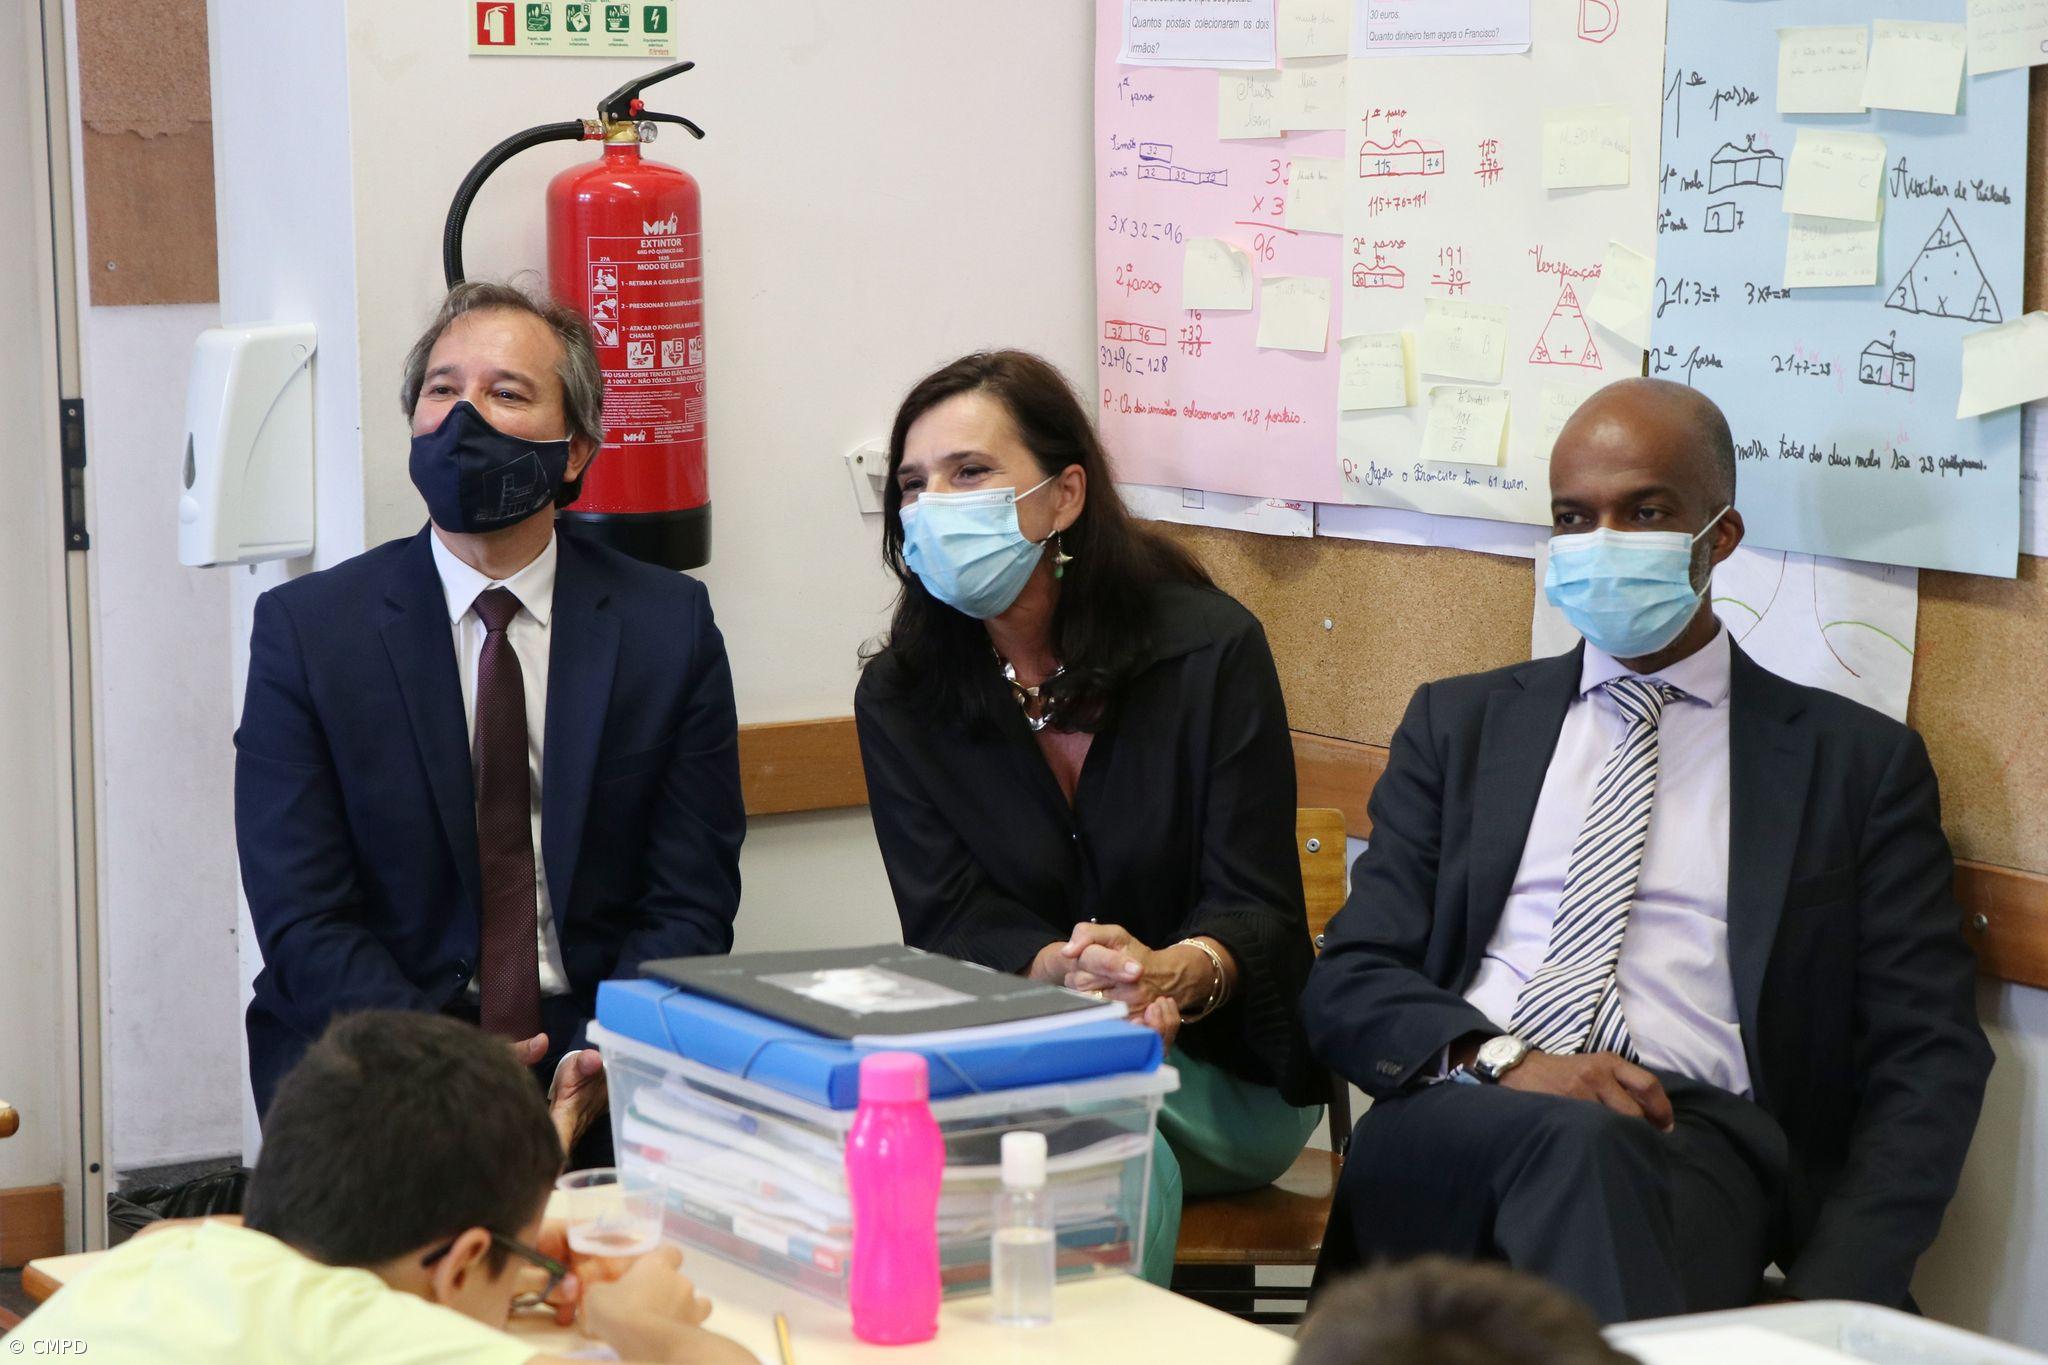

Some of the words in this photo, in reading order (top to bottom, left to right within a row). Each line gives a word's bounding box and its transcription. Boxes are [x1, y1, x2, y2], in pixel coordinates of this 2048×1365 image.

[1131, 16, 1162, 29] Quantos
[1165, 17, 1191, 31] postais
[1194, 18, 1240, 29] colecionaram
[1243, 20, 1252, 30] os
[1255, 18, 1270, 30] dois
[1369, 10, 1378, 20] 30
[1368, 31, 1394, 42] Quanto
[1395, 30, 1422, 41] dinheiro
[1423, 31, 1437, 40] tem
[1437, 31, 1457, 43] agora
[1464, 27, 1500, 39] Francisco?
[1130, 42, 1161, 54] irmãos?
[1131, 91, 1154, 108] passo
[1174, 169, 1188, 182] 32
[1890, 156, 1949, 200] Auxiliar
[1954, 180, 1968, 202] de
[640, 238, 682, 249] EXTINTOR
[1937, 228, 1951, 246] 21
[1253, 232, 1276, 263] 96
[1437, 245, 1462, 267] 191
[637, 263, 660, 271] MODO
[669, 262, 685, 270] USAR
[1528, 244, 1603, 288] Verificação
[1126, 276, 1162, 297] passo
[1897, 286, 1907, 307] 3
[1978, 296, 1991, 321] 7
[1111, 327, 1123, 340] 32
[1138, 327, 1150, 343] 96
[642, 342, 654, 354] A
[1863, 363, 1884, 384] 21
[1895, 361, 1910, 384] 7
[1133, 396, 1147, 415] dois
[1242, 408, 1261, 426] 128
[1779, 432, 1805, 461] total
[1828, 442, 1852, 468] duas
[1918, 455, 1935, 474] 28
[1366, 460, 1394, 487] Agora
[1402, 472, 1409, 483] o
[1413, 462, 1457, 484] Francisco
[1462, 469, 1480, 487] tem
[1488, 475, 1498, 489] 61
